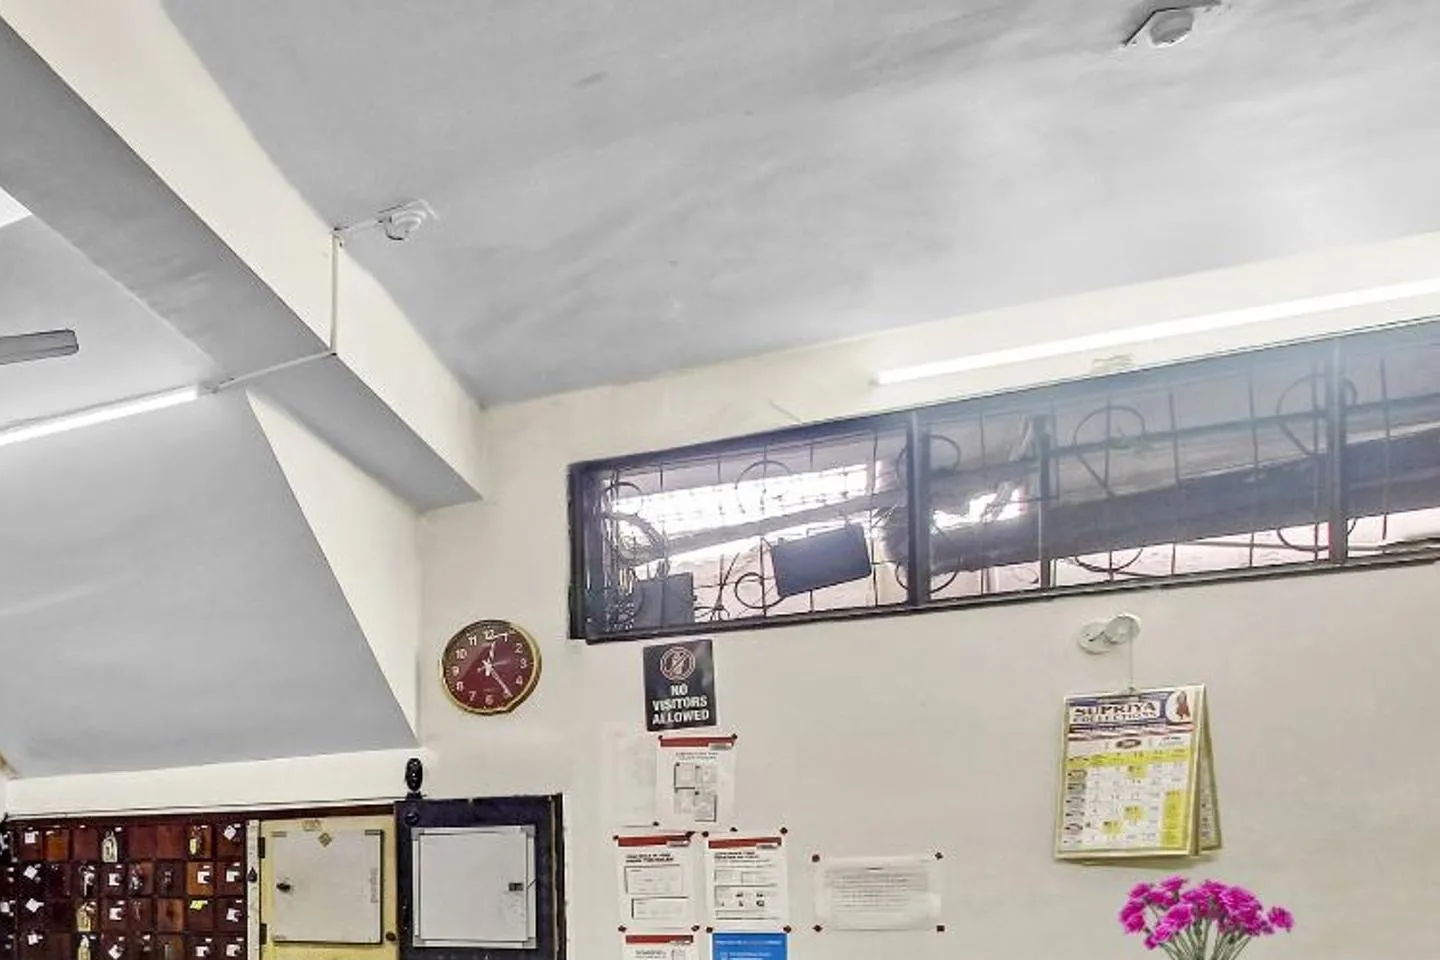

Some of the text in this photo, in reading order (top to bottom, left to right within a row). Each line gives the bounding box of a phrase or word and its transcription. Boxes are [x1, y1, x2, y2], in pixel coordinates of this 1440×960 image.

[468, 635, 477, 646] 11
[455, 648, 468, 660] 10
[514, 642, 523, 654] 2
[520, 658, 528, 669] 3
[469, 690, 477, 701] 7
[670, 683, 689, 696] NO
[652, 695, 708, 711] VISITORS
[1074, 702, 1157, 716] SUPRIYA
[652, 709, 710, 725] ALLOWED
